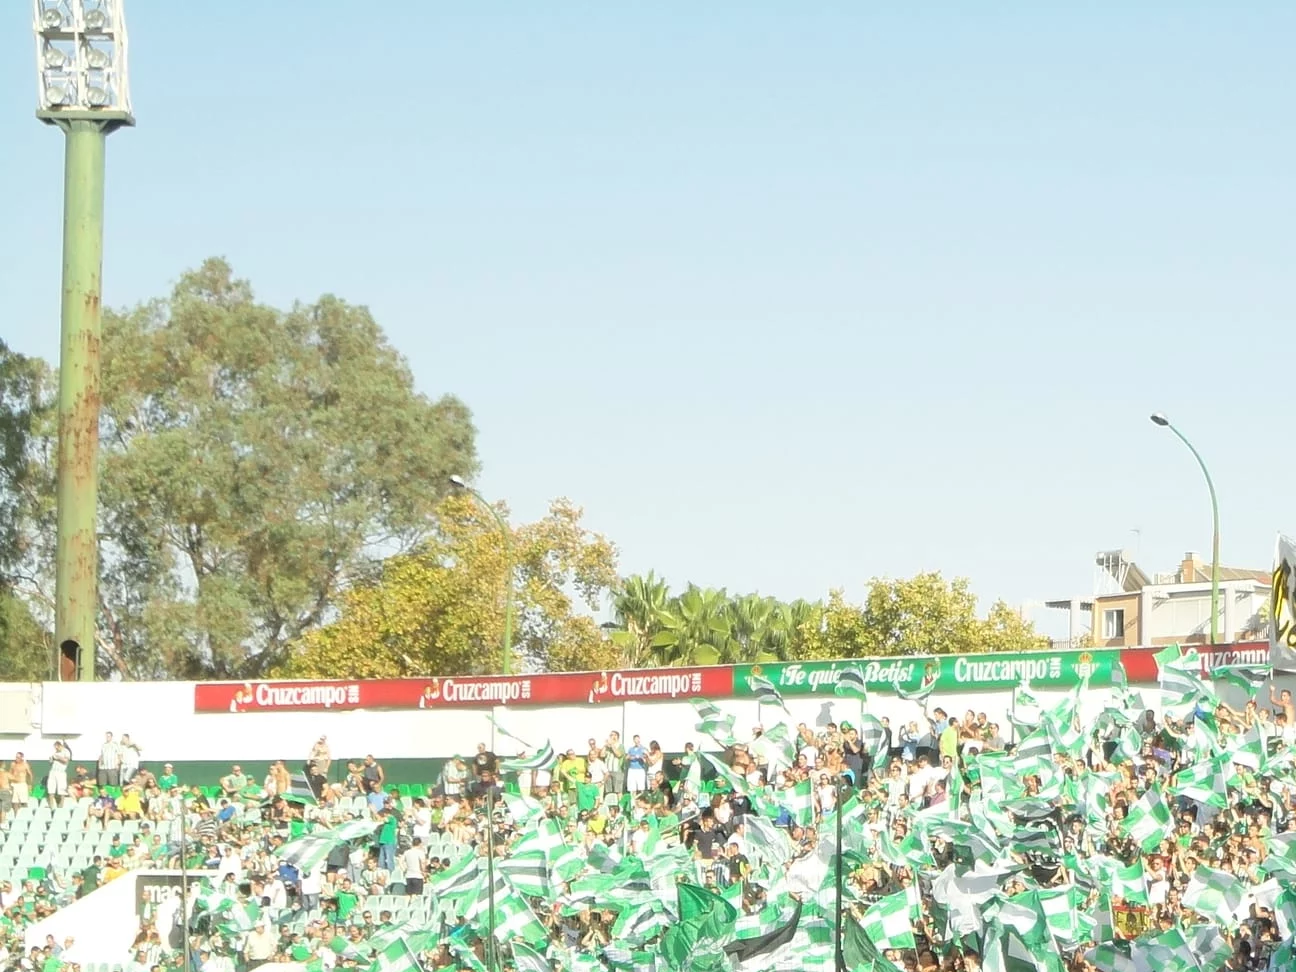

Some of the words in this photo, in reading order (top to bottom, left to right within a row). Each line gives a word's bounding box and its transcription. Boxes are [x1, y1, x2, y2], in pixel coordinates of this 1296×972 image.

[954, 657, 1047, 682] Cruzcampo
[255, 684, 346, 708] Cruzcampo
[443, 679, 521, 704] Cruzcampo
[611, 672, 689, 698] Cruzcampo
